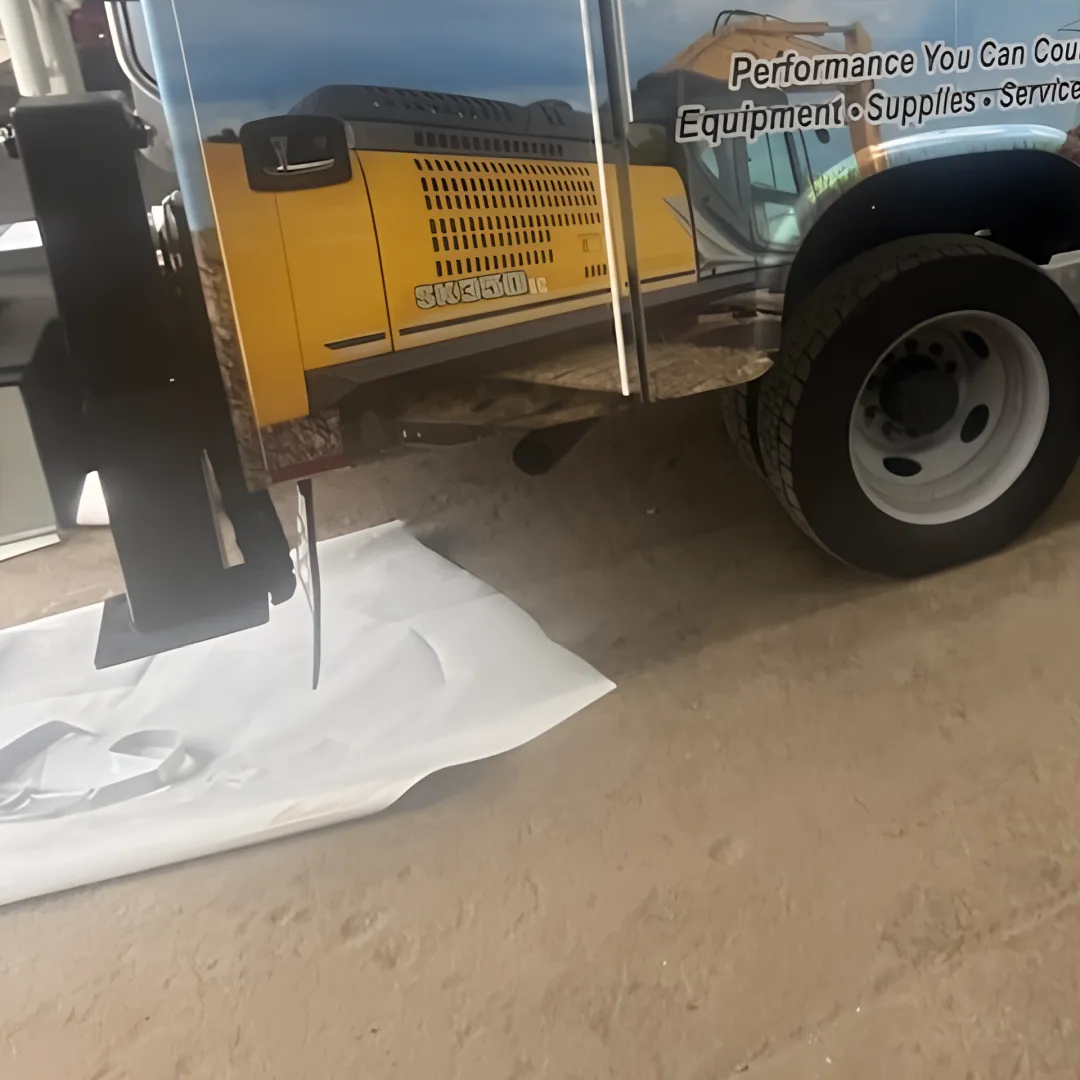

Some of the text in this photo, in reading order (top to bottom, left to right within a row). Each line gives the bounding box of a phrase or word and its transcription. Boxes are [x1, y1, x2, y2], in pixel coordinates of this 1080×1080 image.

[731, 51, 915, 88] Performance
[924, 43, 971, 72] You
[980, 40, 1026, 68] Can
[678, 98, 843, 144] Equipment
[867, 86, 977, 127] Supplies
